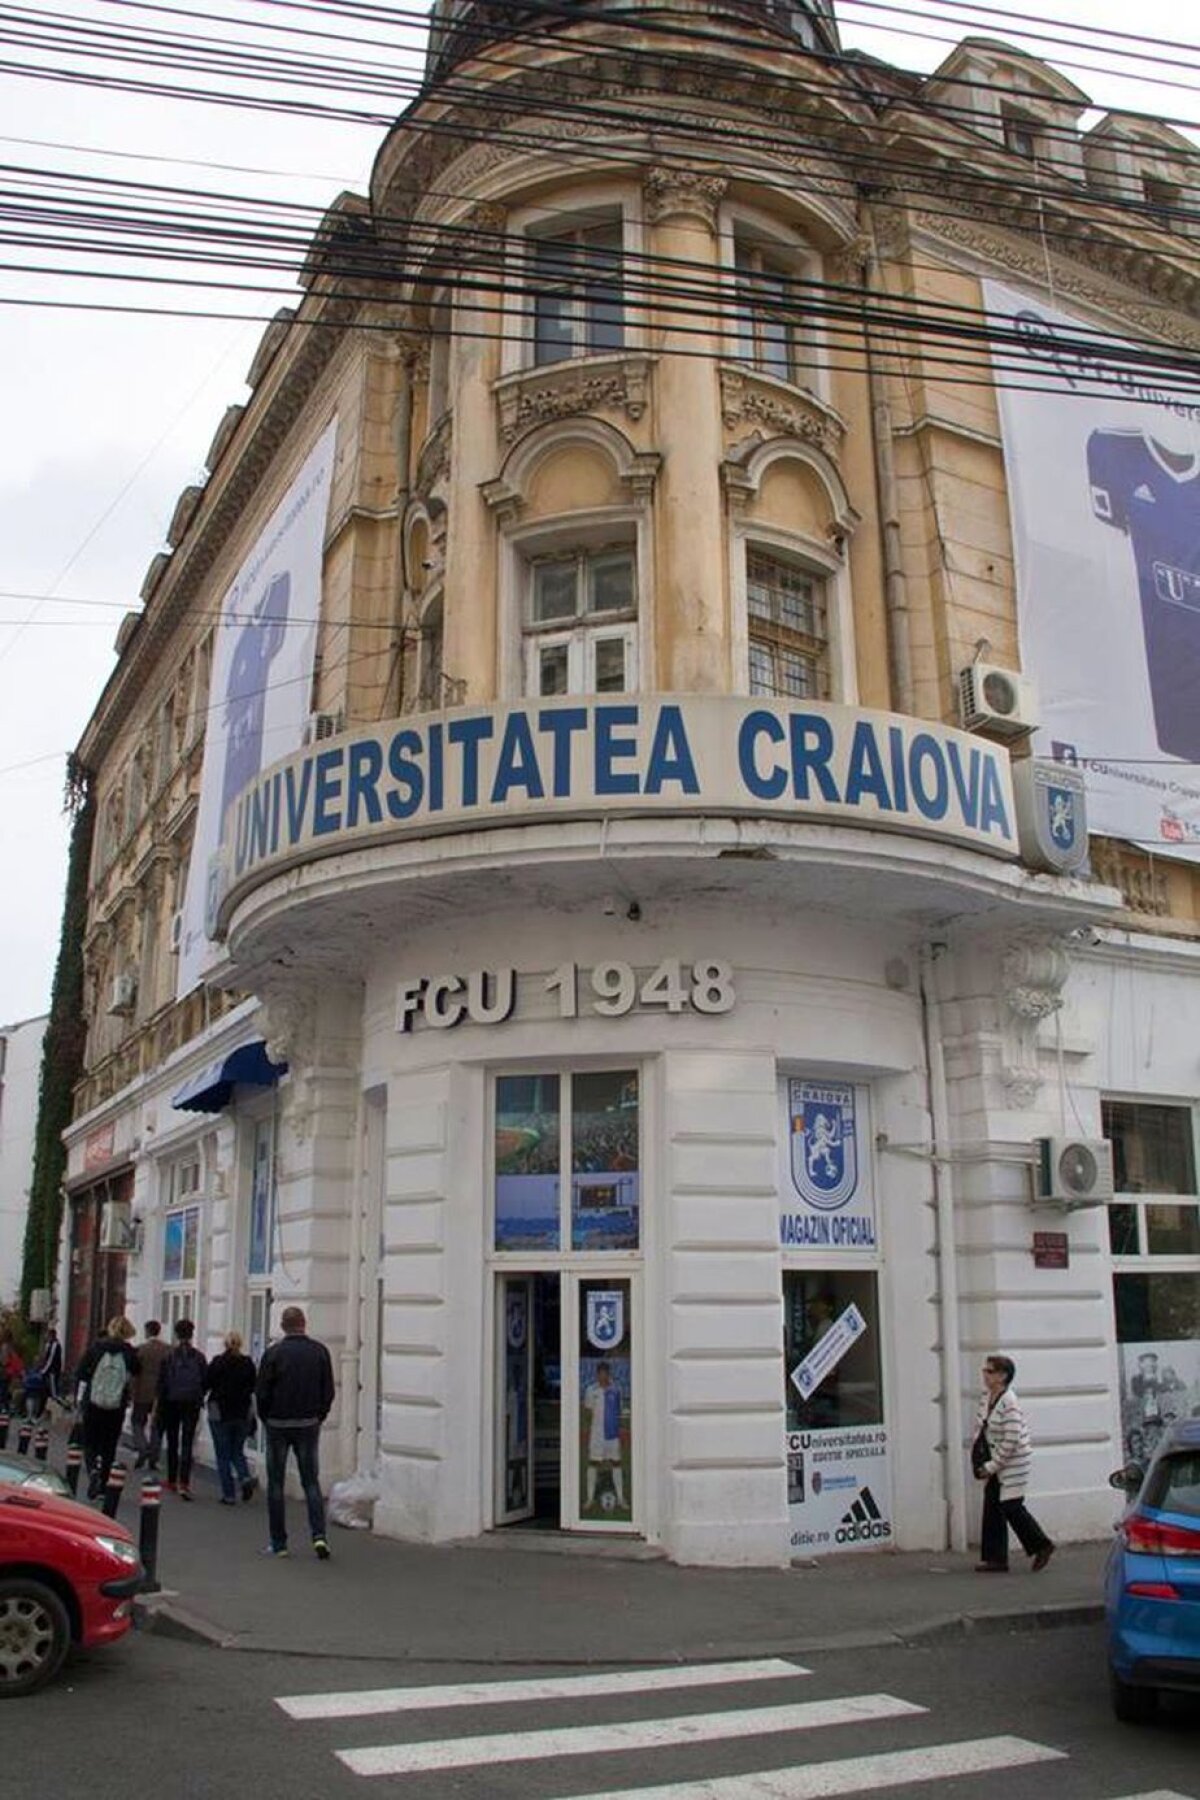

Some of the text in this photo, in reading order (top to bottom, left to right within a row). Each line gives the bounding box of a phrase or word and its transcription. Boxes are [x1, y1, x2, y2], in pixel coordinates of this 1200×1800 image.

[233, 706, 1012, 875] UNIVERSITATEA CRAIOVA
[396, 961, 735, 1033] FCU 1948
[832, 1216, 875, 1246] OFICIAL
[788, 1431, 887, 1450] CUniversitatea.ro
[835, 1521, 892, 1544] adidas
